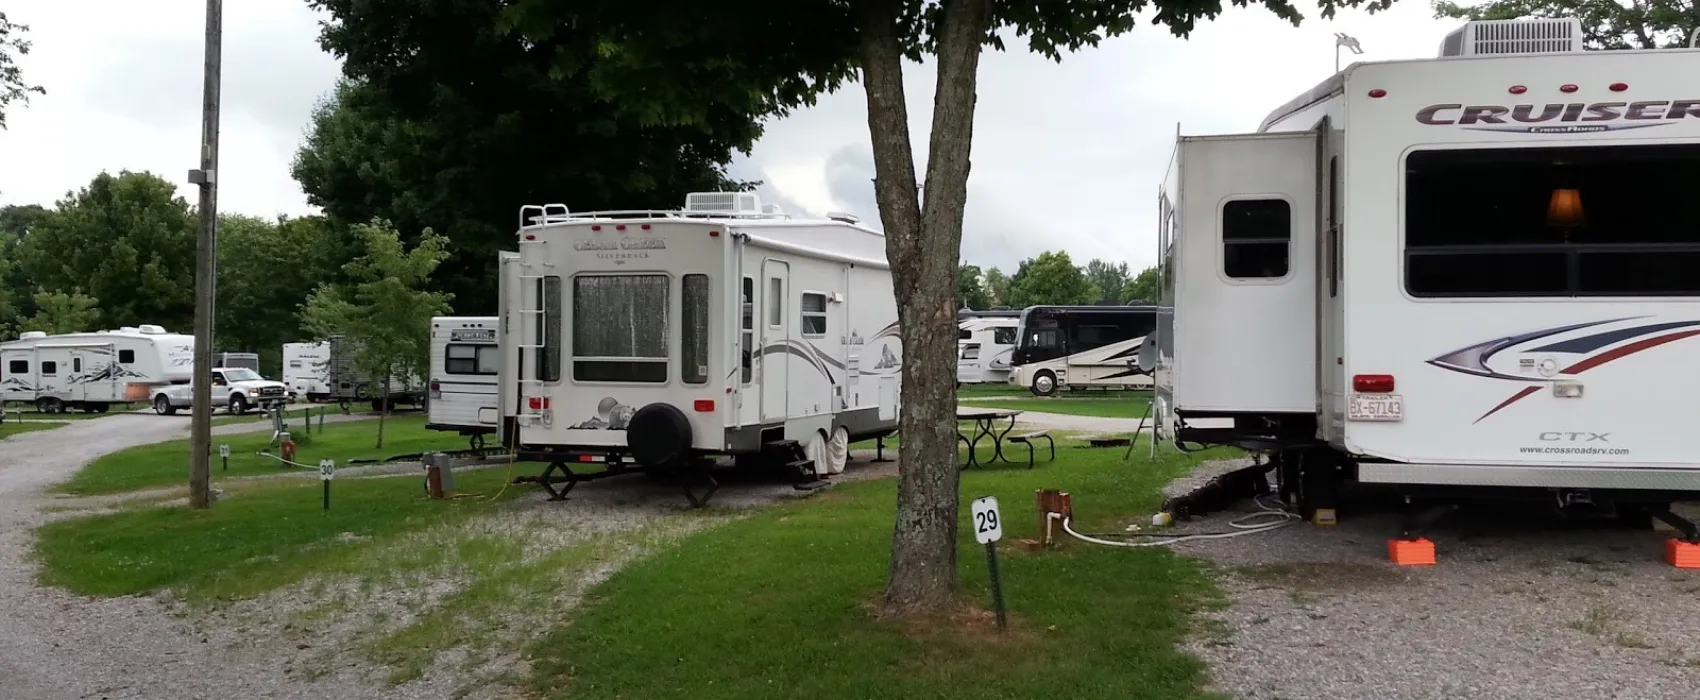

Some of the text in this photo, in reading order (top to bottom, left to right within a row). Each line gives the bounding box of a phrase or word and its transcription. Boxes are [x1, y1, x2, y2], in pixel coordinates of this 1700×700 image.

[1415, 101, 1700, 125] CRUISER
[1350, 401, 1401, 415] BX-67143
[1538, 432, 1611, 442] CTX
[1519, 446, 1630, 456] www.crossroadsrv.com
[321, 465, 333, 476] 30
[976, 509, 998, 534] 29
